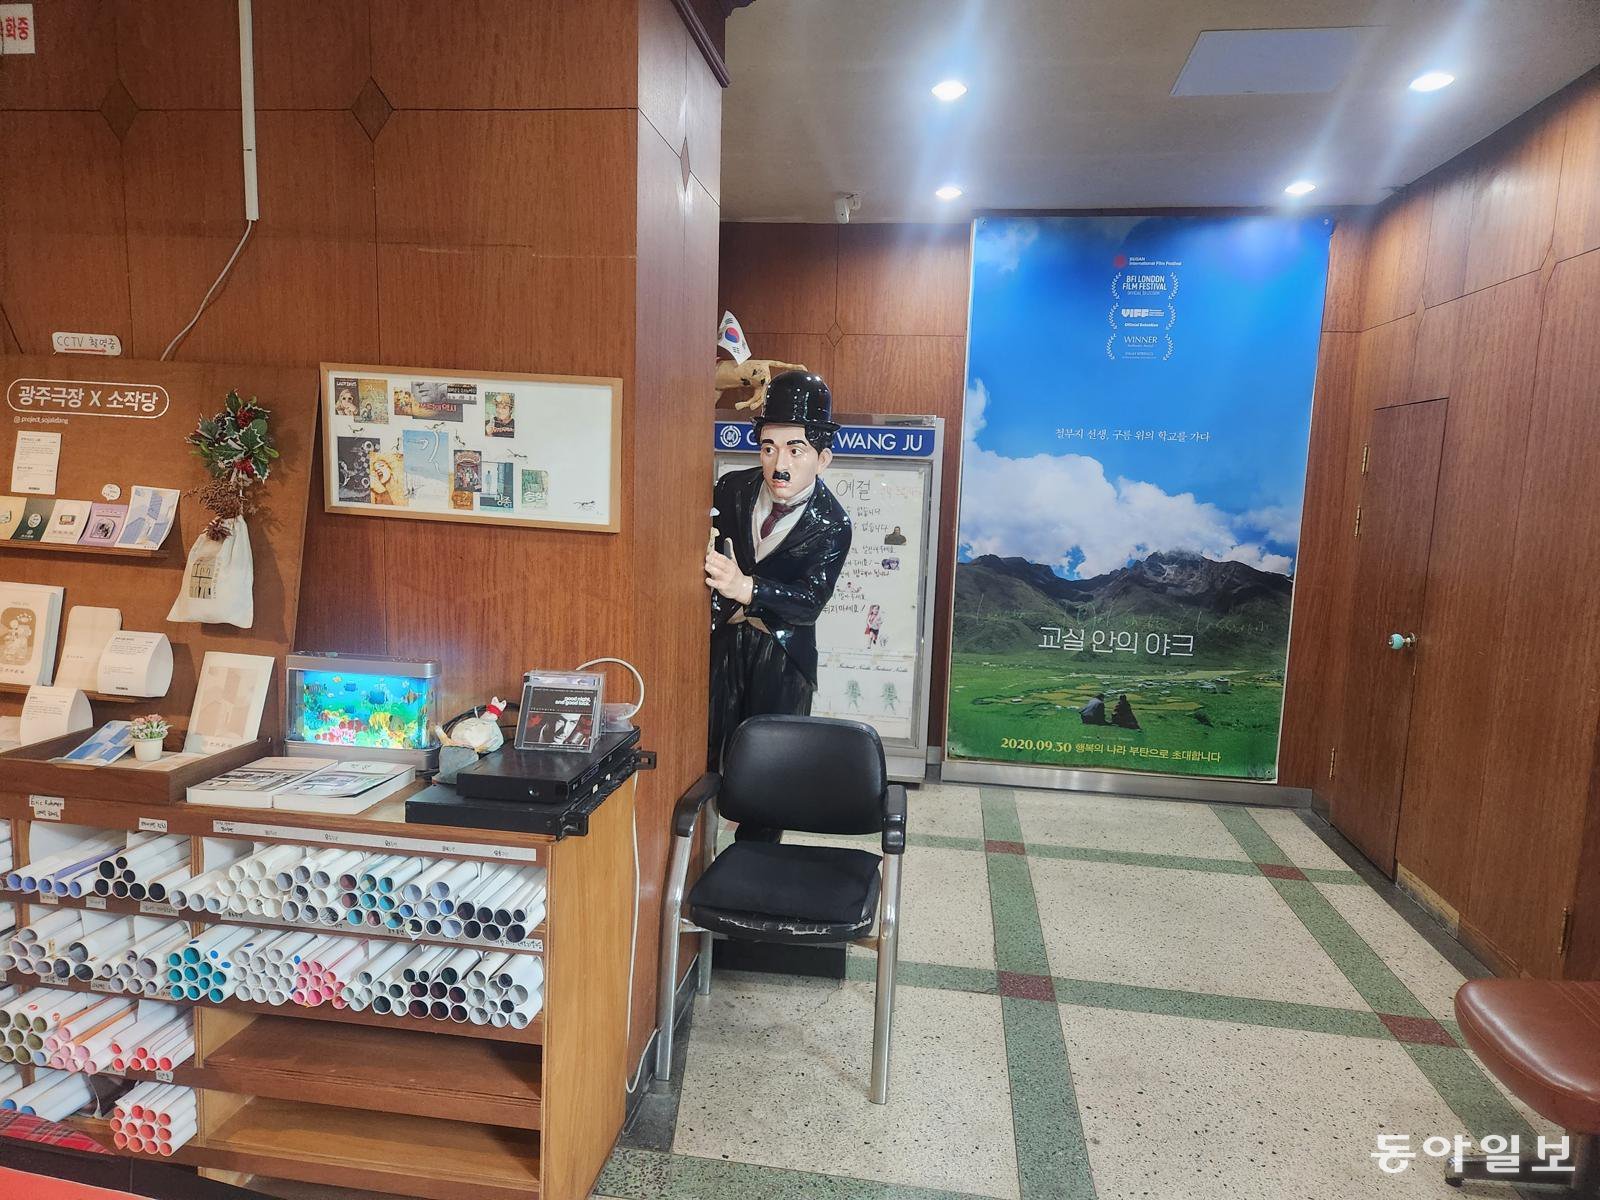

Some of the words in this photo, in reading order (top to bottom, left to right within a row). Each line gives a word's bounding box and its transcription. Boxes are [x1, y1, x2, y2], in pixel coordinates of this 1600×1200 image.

[0, 16, 29, 40] 화중
[1126, 275, 1137, 283] BFI
[1138, 275, 1165, 283] LONDON
[1139, 283, 1167, 291] FESTIVAL
[1121, 308, 1149, 318] VIFF
[56, 335, 84, 347] CCTV
[1123, 336, 1158, 344] WINNER
[18, 385, 85, 408] 광주극장
[89, 390, 102, 407] X
[106, 391, 159, 413] 소작당
[832, 433, 896, 451] WANG
[903, 435, 923, 451] JU
[1055, 428, 1084, 440] 철부지
[1112, 429, 1131, 441] 구름
[1135, 430, 1154, 442] 위의
[1158, 431, 1187, 443] 학교를
[1190, 432, 1210, 442] 가다
[1038, 626, 1085, 651] 교실
[1090, 629, 1139, 655] 안의
[1144, 632, 1194, 657] 야크
[1000, 737, 1072, 754] 2020.09.30
[1075, 742, 1104, 755] 행복의
[1106, 743, 1126, 756] 나라
[1129, 745, 1169, 760] 부탄으로
[1171, 747, 1221, 763] 초대합니다
